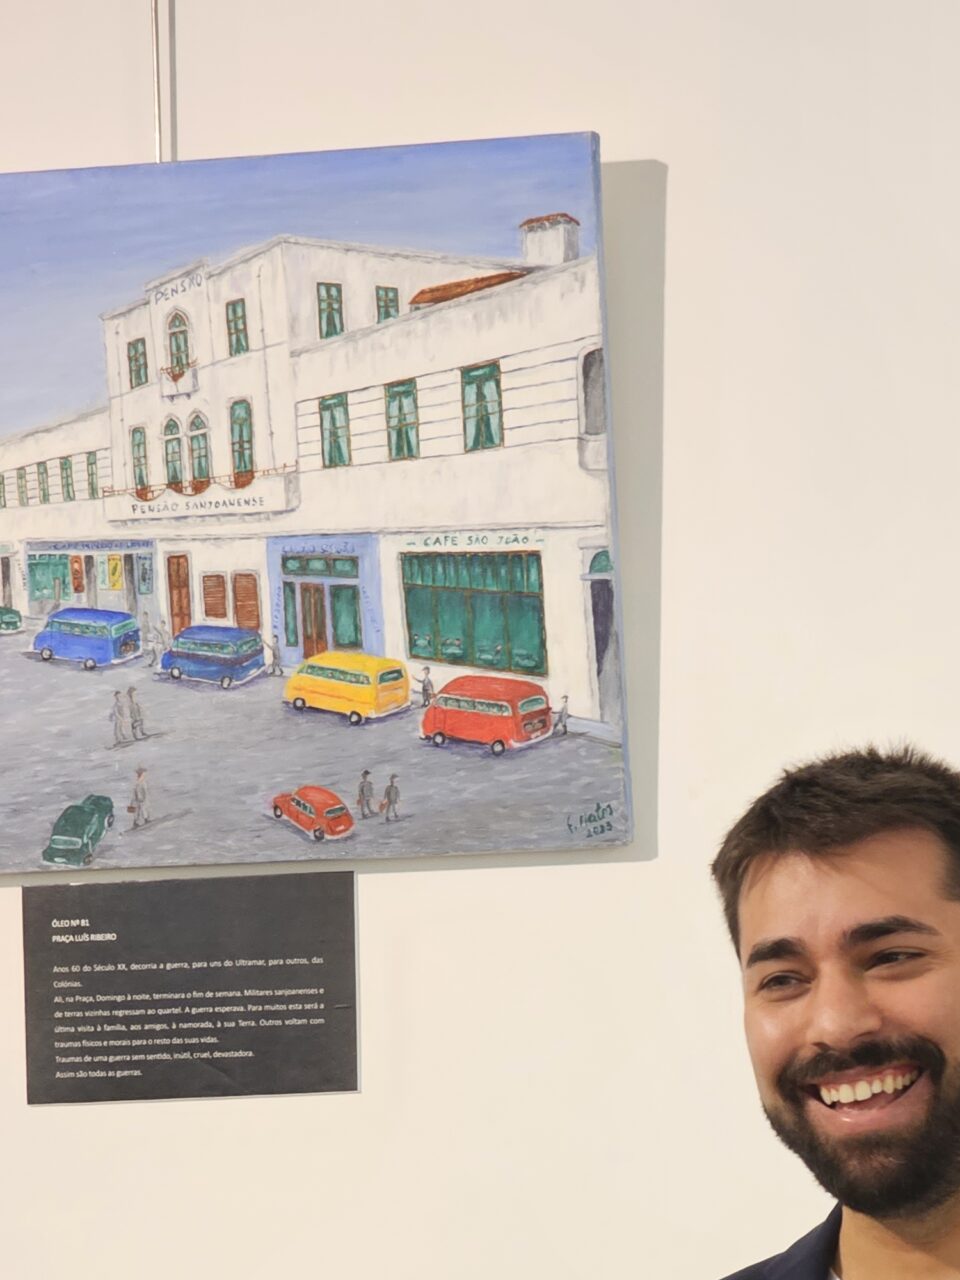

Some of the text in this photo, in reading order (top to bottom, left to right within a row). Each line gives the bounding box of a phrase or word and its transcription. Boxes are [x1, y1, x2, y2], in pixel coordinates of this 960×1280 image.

[51, 918, 69, 928] ÓLEO
[52, 933, 117, 943] PRAÇA LUÍS RIBEIRO
[83, 964, 92, 972] do
[93, 963, 115, 971] Século
[96, 994, 125, 1002] Domingo
[153, 992, 185, 1000] terminara
[193, 990, 204, 998] fim
[85, 1009, 110, 1017] vizinhas
[112, 1009, 145, 1017] regressam
[191, 1006, 213, 1014] guerra
[264, 1003, 287, 1011] muitos
[109, 1055, 131, 1063] guerra
